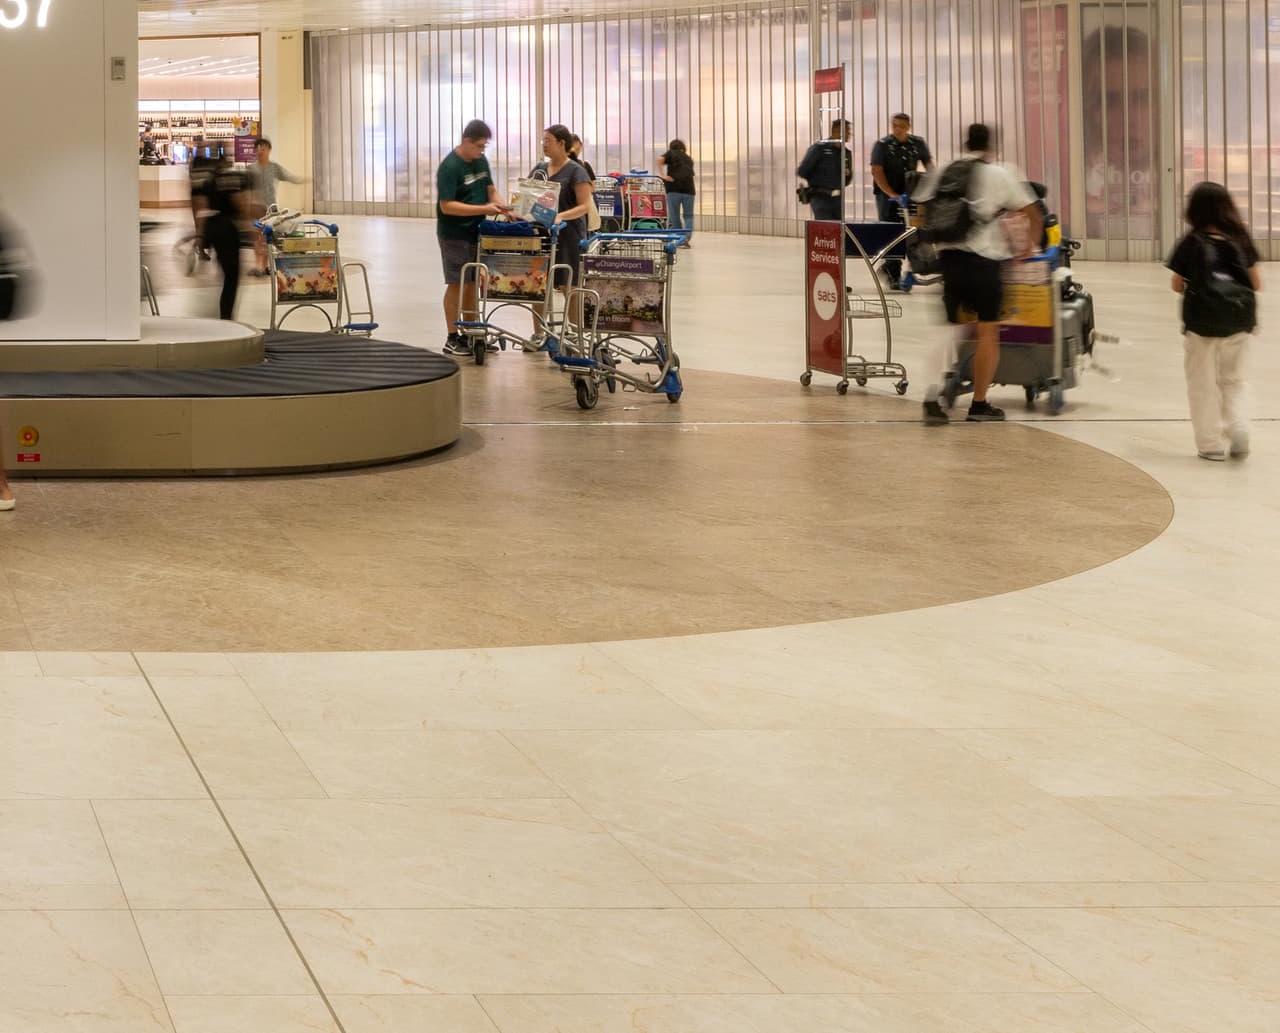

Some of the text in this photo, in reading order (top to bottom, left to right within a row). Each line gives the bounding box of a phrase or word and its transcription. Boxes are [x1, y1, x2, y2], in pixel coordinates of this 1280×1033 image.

[814, 236, 837, 249] Arrival
[810, 250, 840, 265] Services
[817, 290, 837, 303] sats
